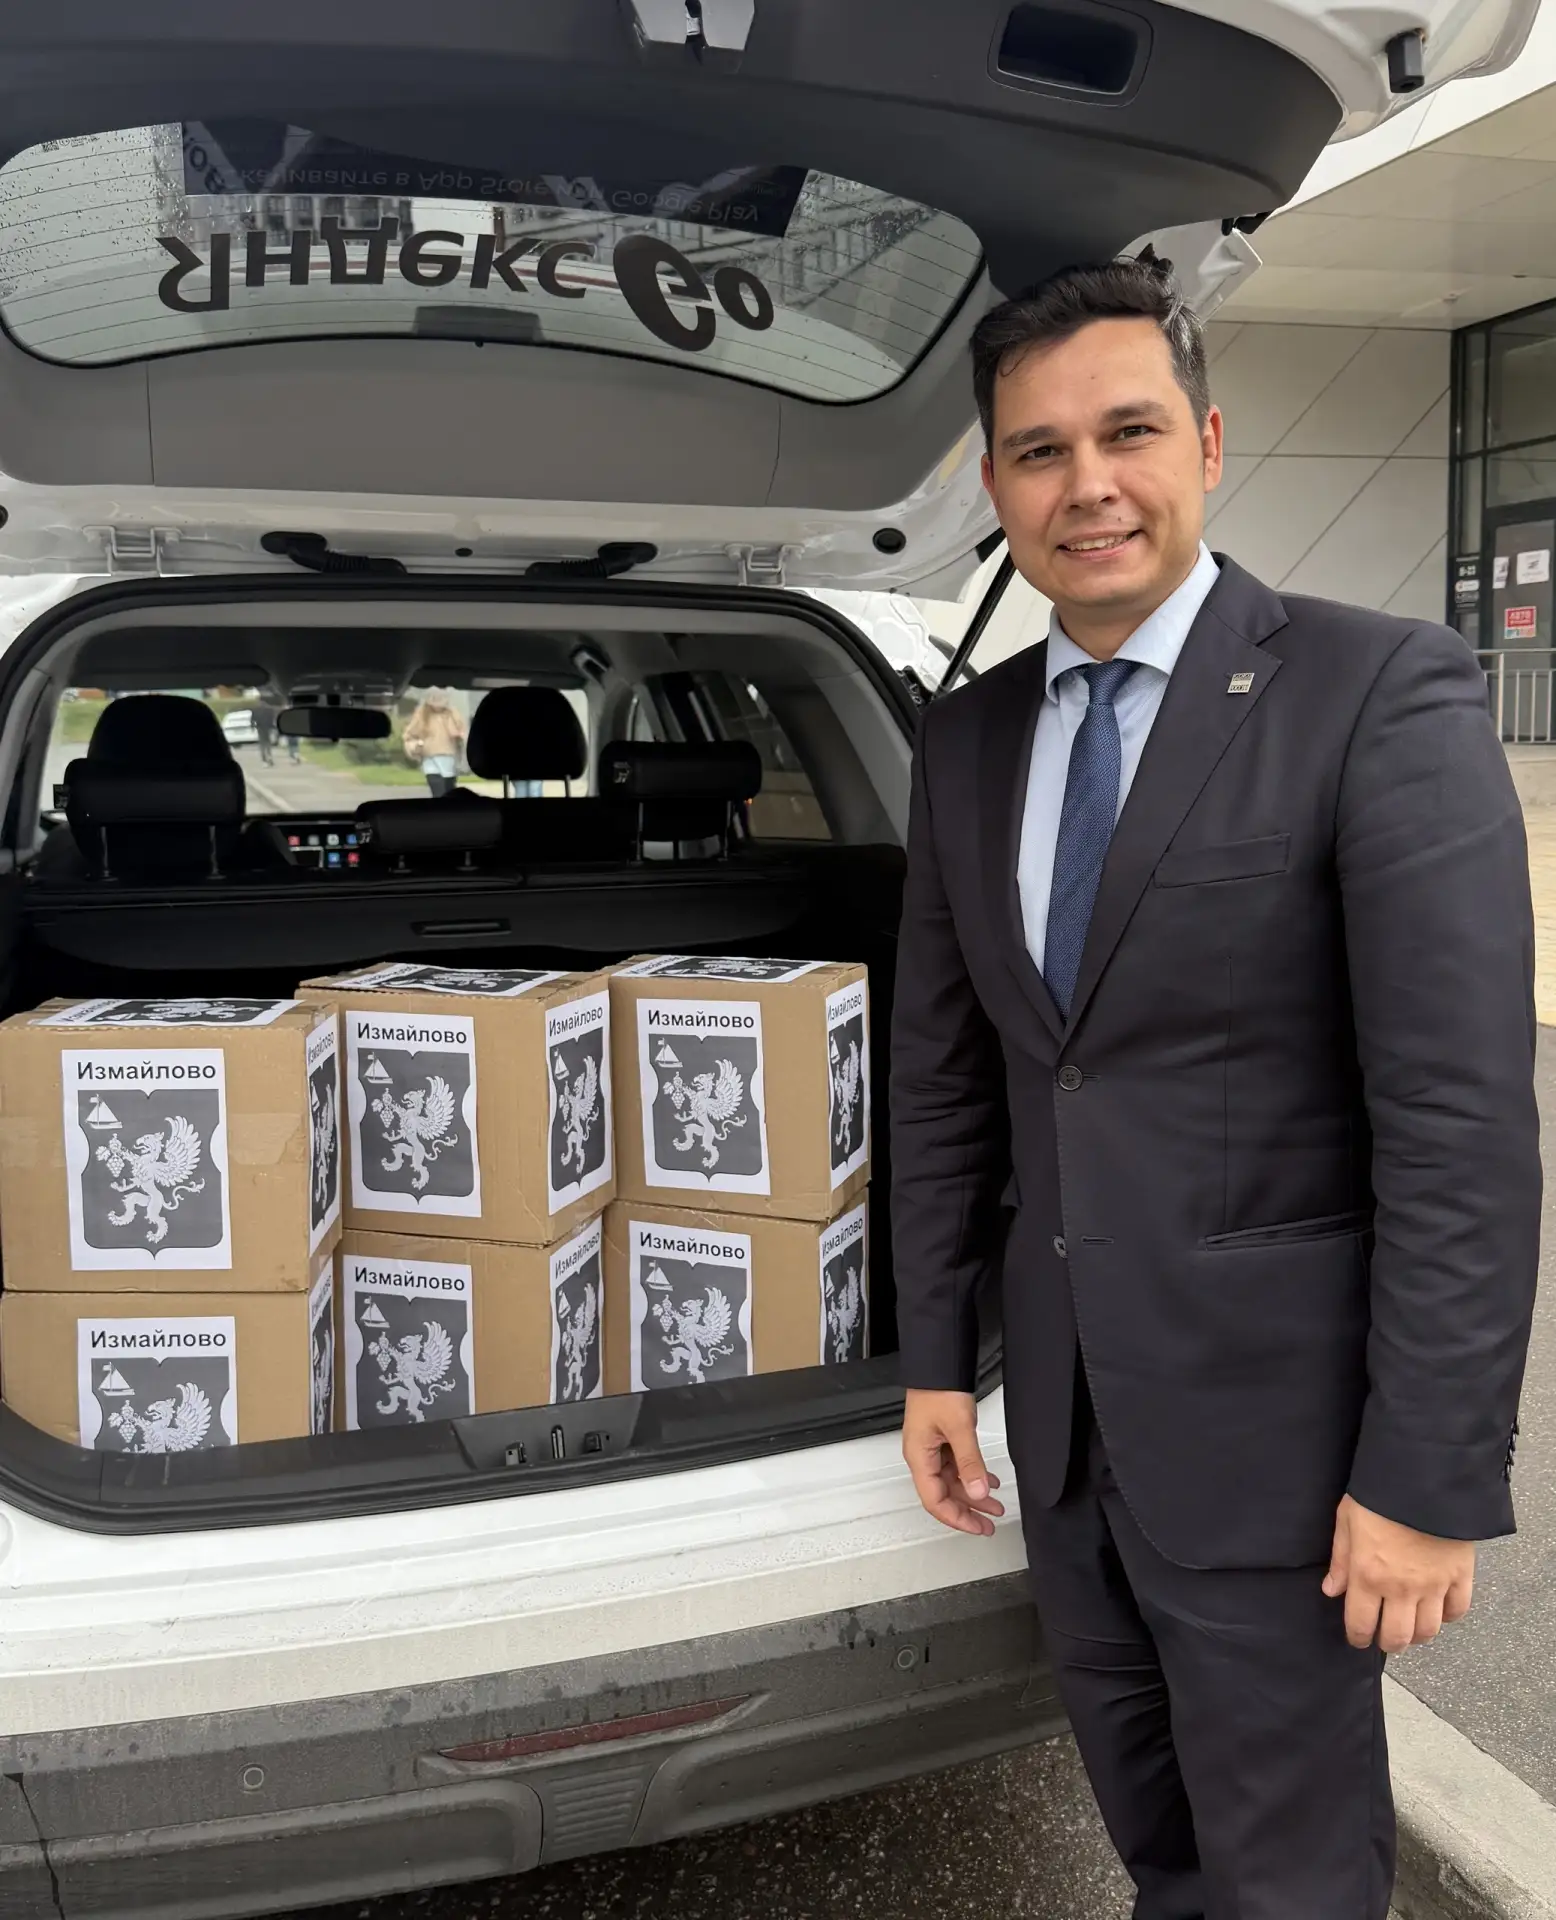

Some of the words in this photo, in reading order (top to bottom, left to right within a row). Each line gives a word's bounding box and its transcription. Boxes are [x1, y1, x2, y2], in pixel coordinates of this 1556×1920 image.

[549, 1005, 603, 1037] Измайлово
[648, 1010, 754, 1029] Измайлово
[828, 993, 863, 1022] Измайлово
[357, 1023, 467, 1044] Измайлово
[77, 1061, 216, 1081] Измайлово
[640, 1231, 745, 1260] Измайлово
[822, 1216, 864, 1256] Измайлово
[555, 1231, 600, 1278] Измайлово
[355, 1266, 465, 1291] Измайлово
[91, 1329, 227, 1349] Измайлово
